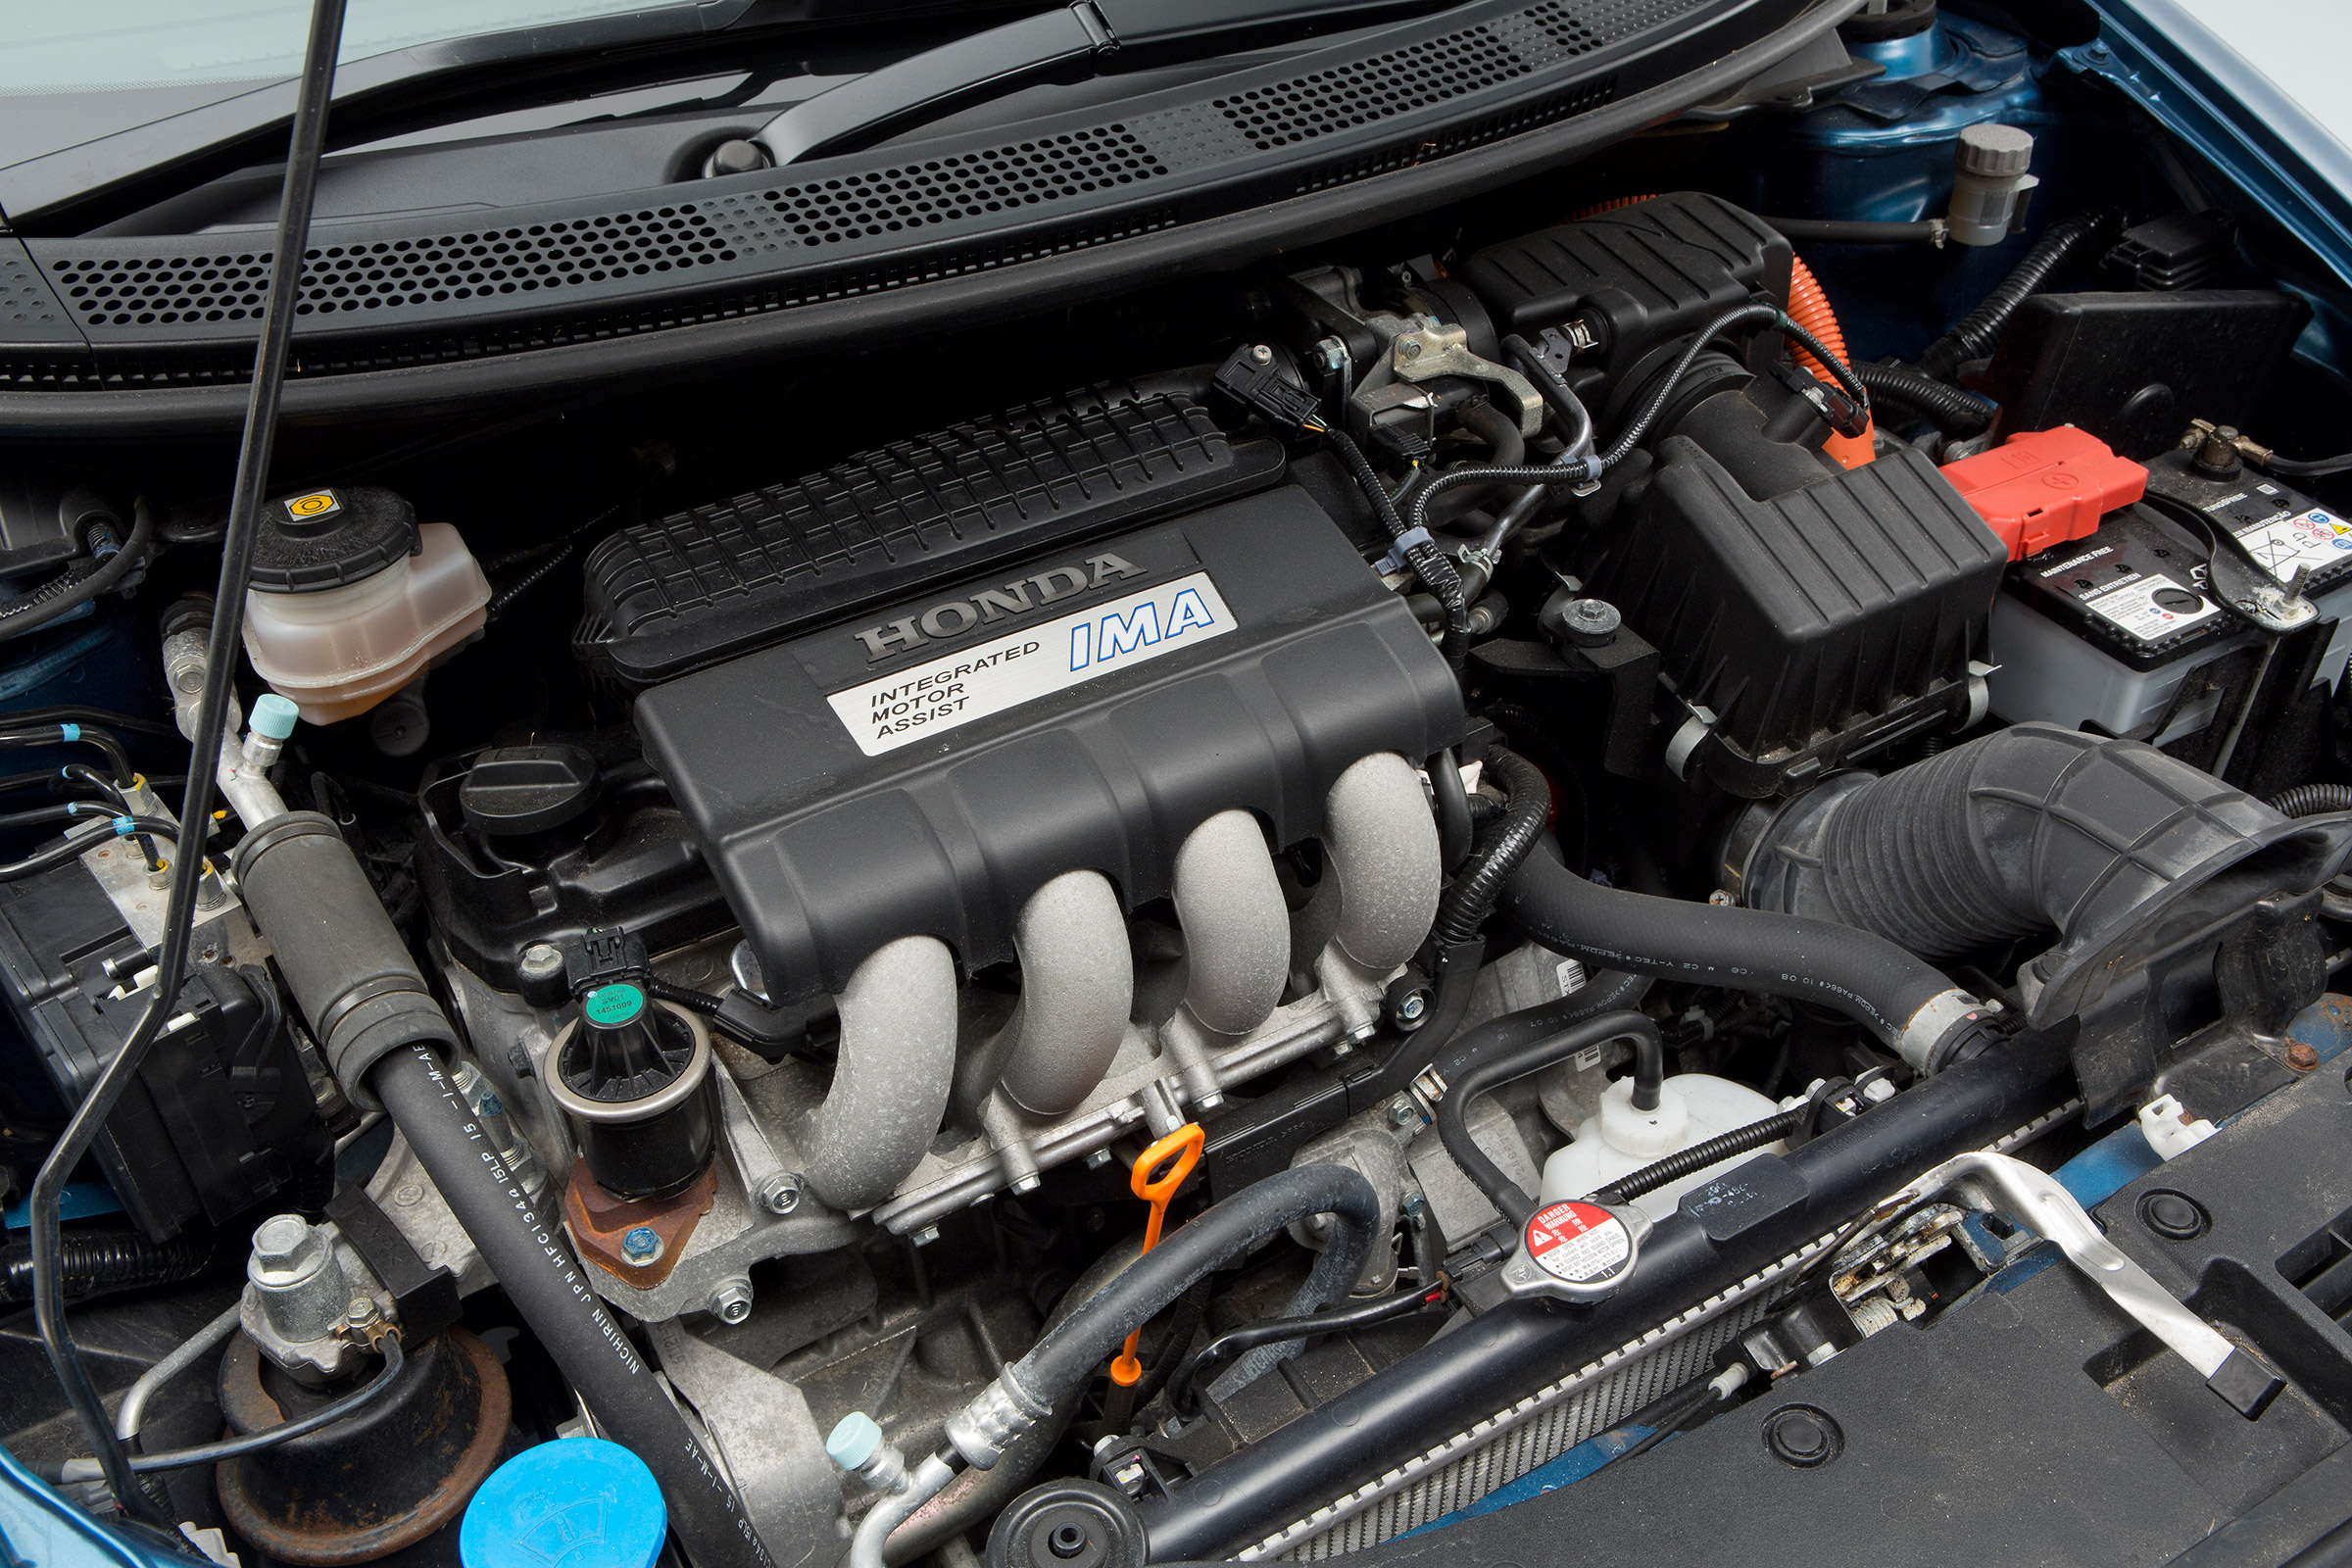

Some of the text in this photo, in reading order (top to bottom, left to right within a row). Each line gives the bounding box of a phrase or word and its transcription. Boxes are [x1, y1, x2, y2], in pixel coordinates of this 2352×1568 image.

[2244, 511, 2291, 536] MANUTENÇÃO
[2040, 546, 2115, 578] MAINTENANCE FREE
[2079, 587, 2102, 602] SANS
[2101, 572, 2142, 594] ENTRETIEN
[854, 553, 1149, 663] HONDA
[1070, 588, 1214, 671] IMA
[871, 641, 1040, 708] INTEGRATED
[871, 682, 965, 724] MOTOR
[876, 696, 970, 739] ASSIST
[1537, 1203, 1571, 1224] DANGER
[1544, 1210, 1577, 1230] WARNUNG
[564, 1270, 592, 1303] JPN
[1601, 1266, 1616, 1279] 1.1
[591, 1308, 640, 1375] NICHIRIN
